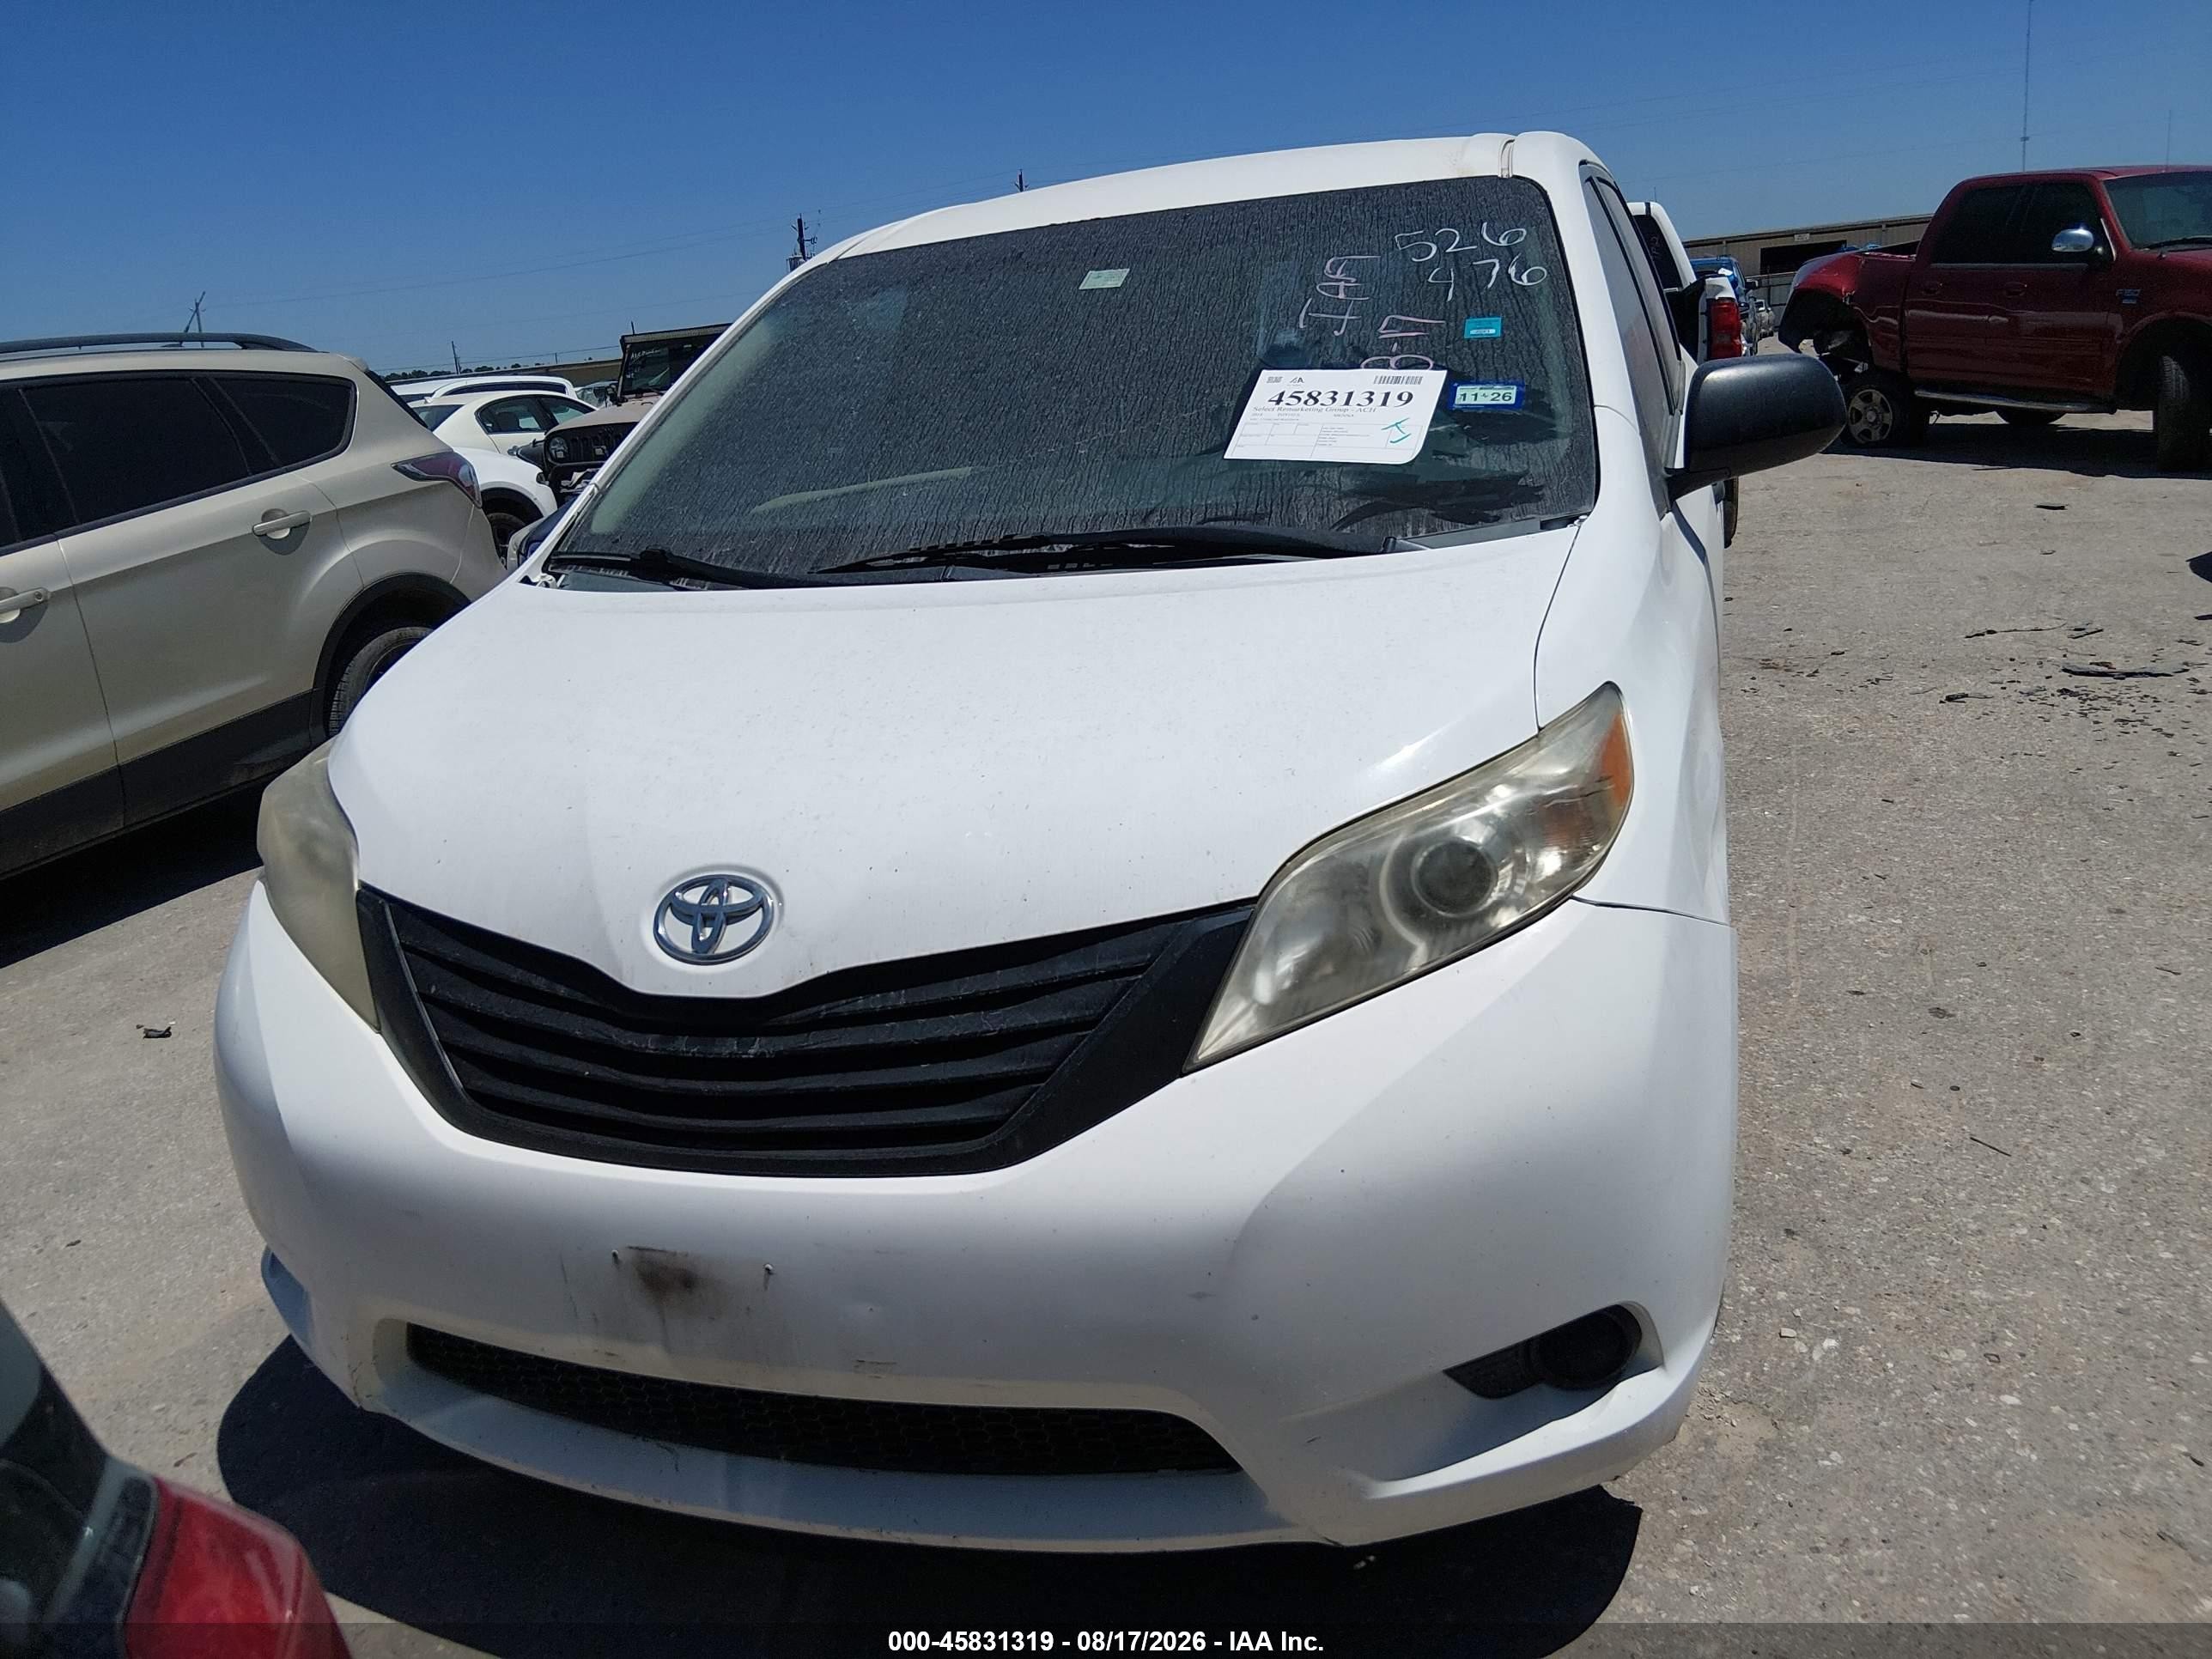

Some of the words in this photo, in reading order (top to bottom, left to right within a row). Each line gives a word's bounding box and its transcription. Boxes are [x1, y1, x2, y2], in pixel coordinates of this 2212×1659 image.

[1395, 222, 1527, 262] 526
[1428, 255, 1547, 301] 476
[1267, 390, 1413, 407] 45831319
